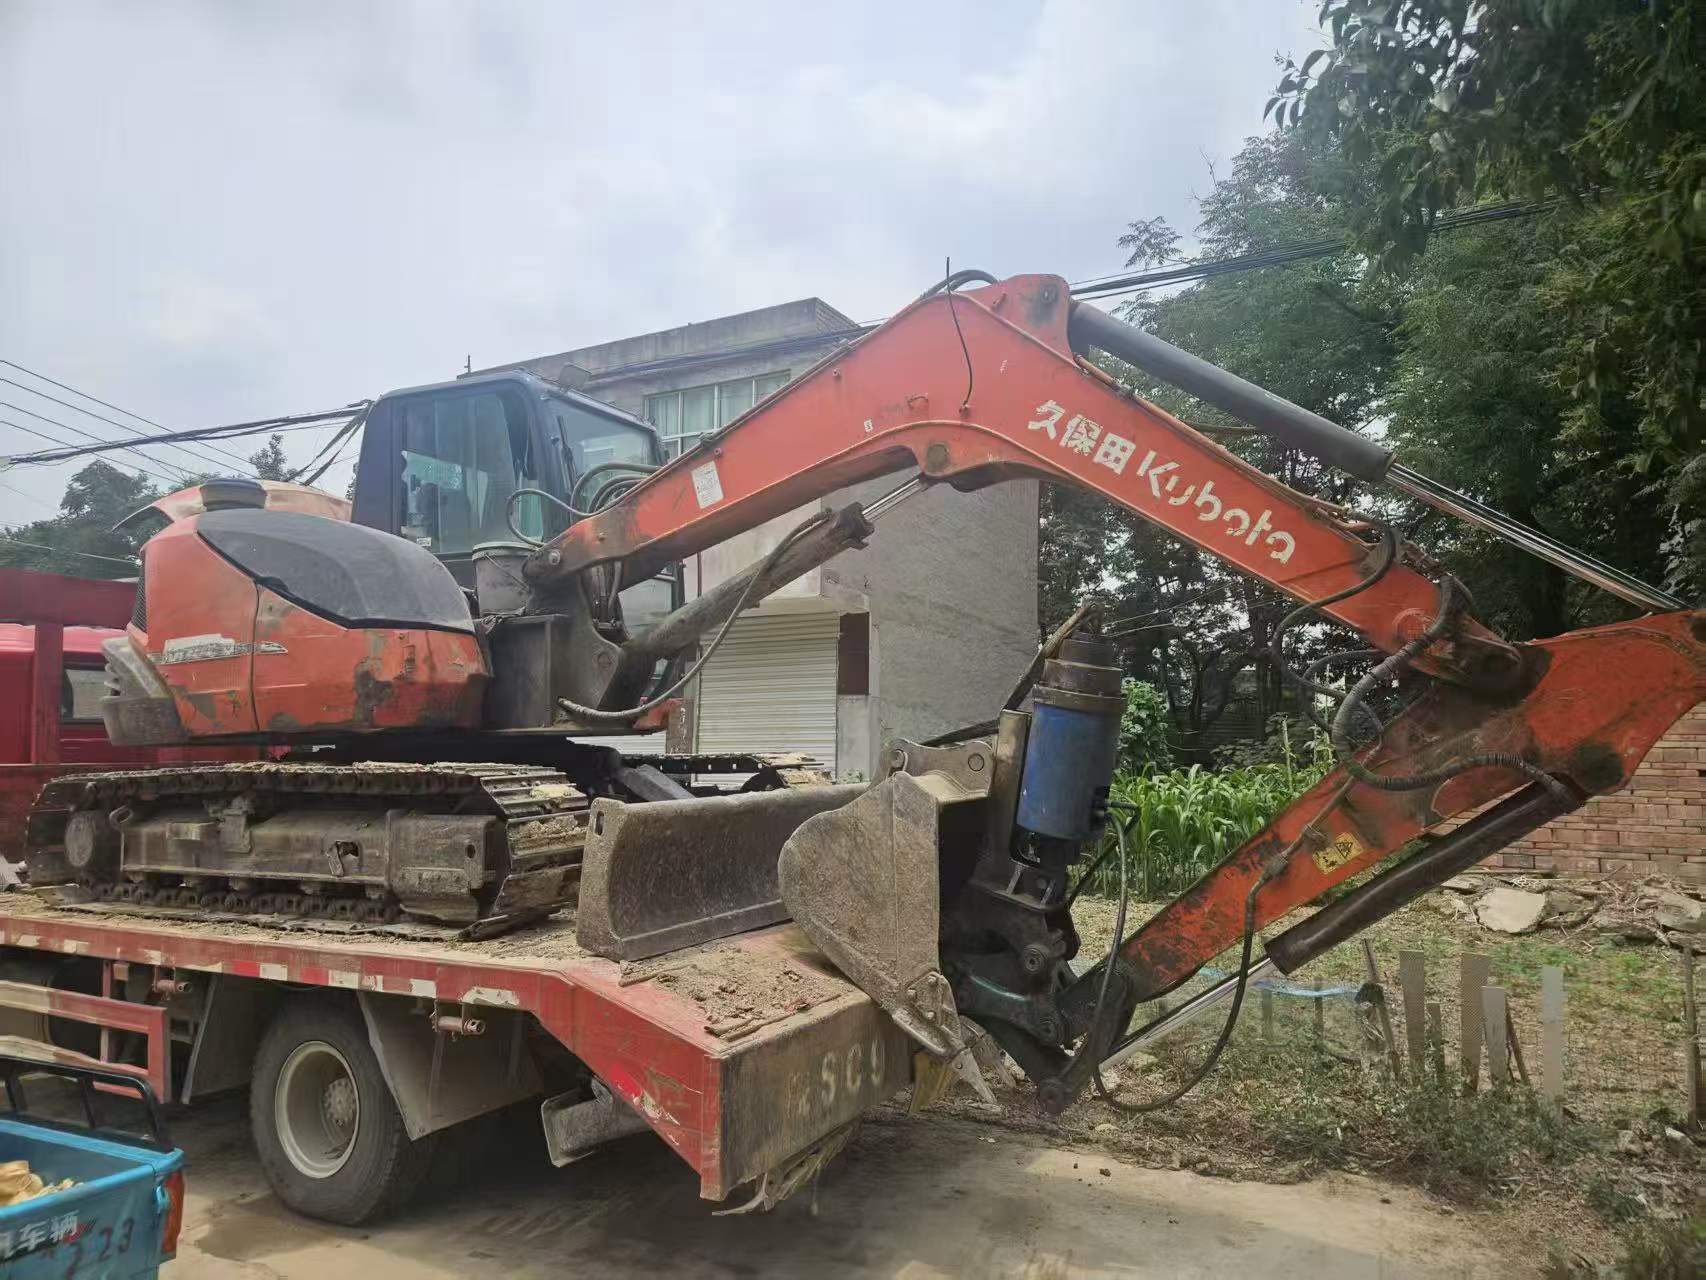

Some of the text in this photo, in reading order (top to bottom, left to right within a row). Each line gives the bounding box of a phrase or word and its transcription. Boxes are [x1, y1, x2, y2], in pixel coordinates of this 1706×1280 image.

[1027, 400, 1296, 565] 久保田 Kubota
